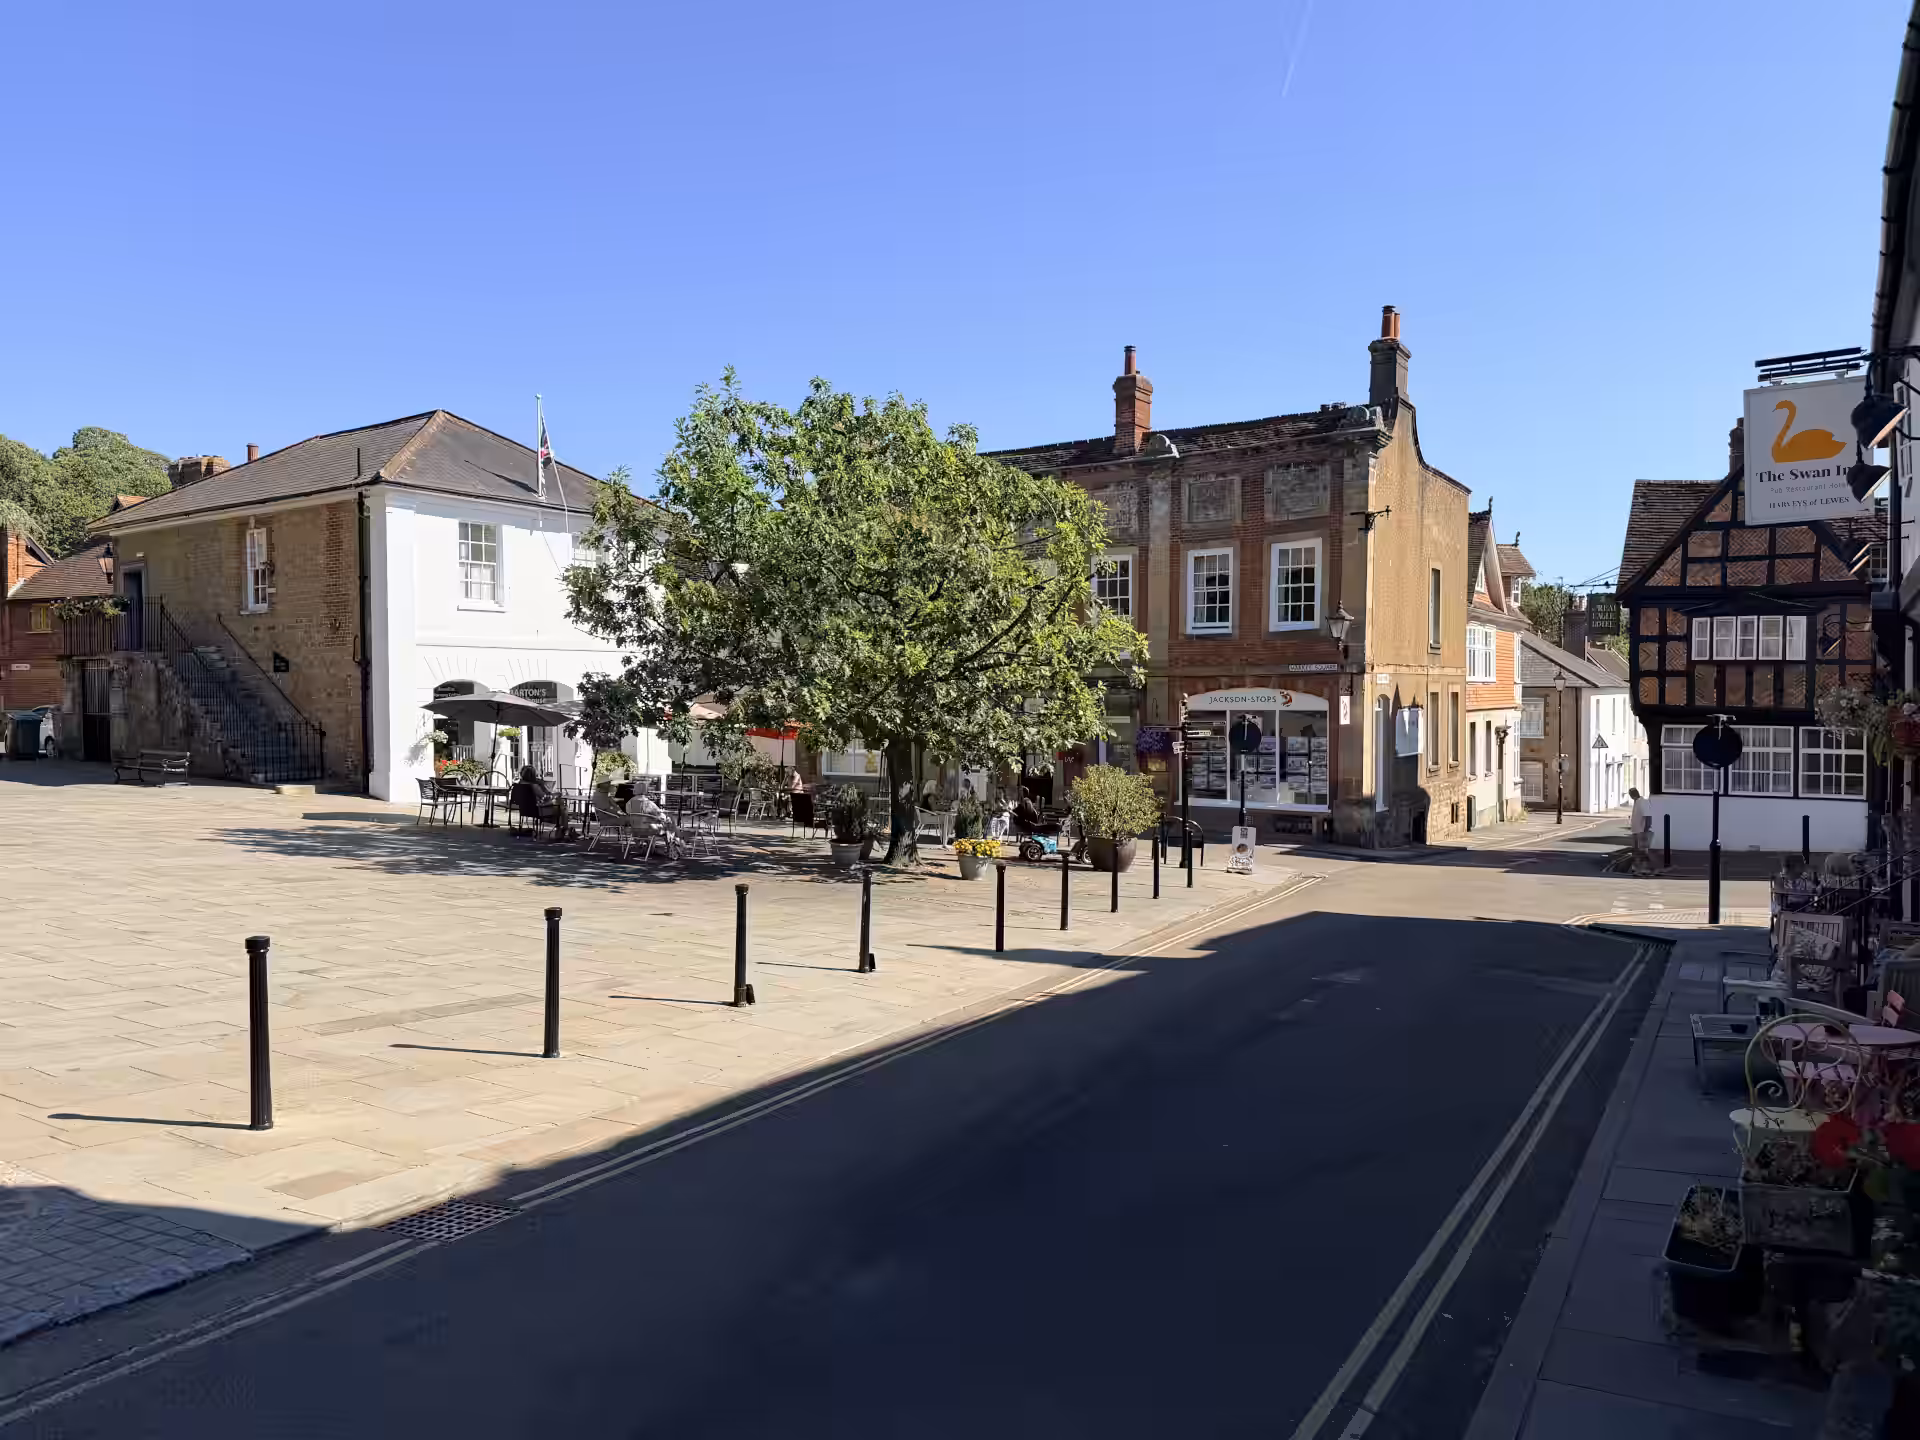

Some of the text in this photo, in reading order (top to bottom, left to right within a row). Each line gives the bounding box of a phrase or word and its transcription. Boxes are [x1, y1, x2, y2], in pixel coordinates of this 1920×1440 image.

[1755, 464, 1852, 483] The Swan In
[1770, 482, 1849, 494] Pub Restaurant Hot
[1769, 496, 1850, 509] HARVEYS of LEWES
[1208, 694, 1277, 705] JACKSON-STOPS
